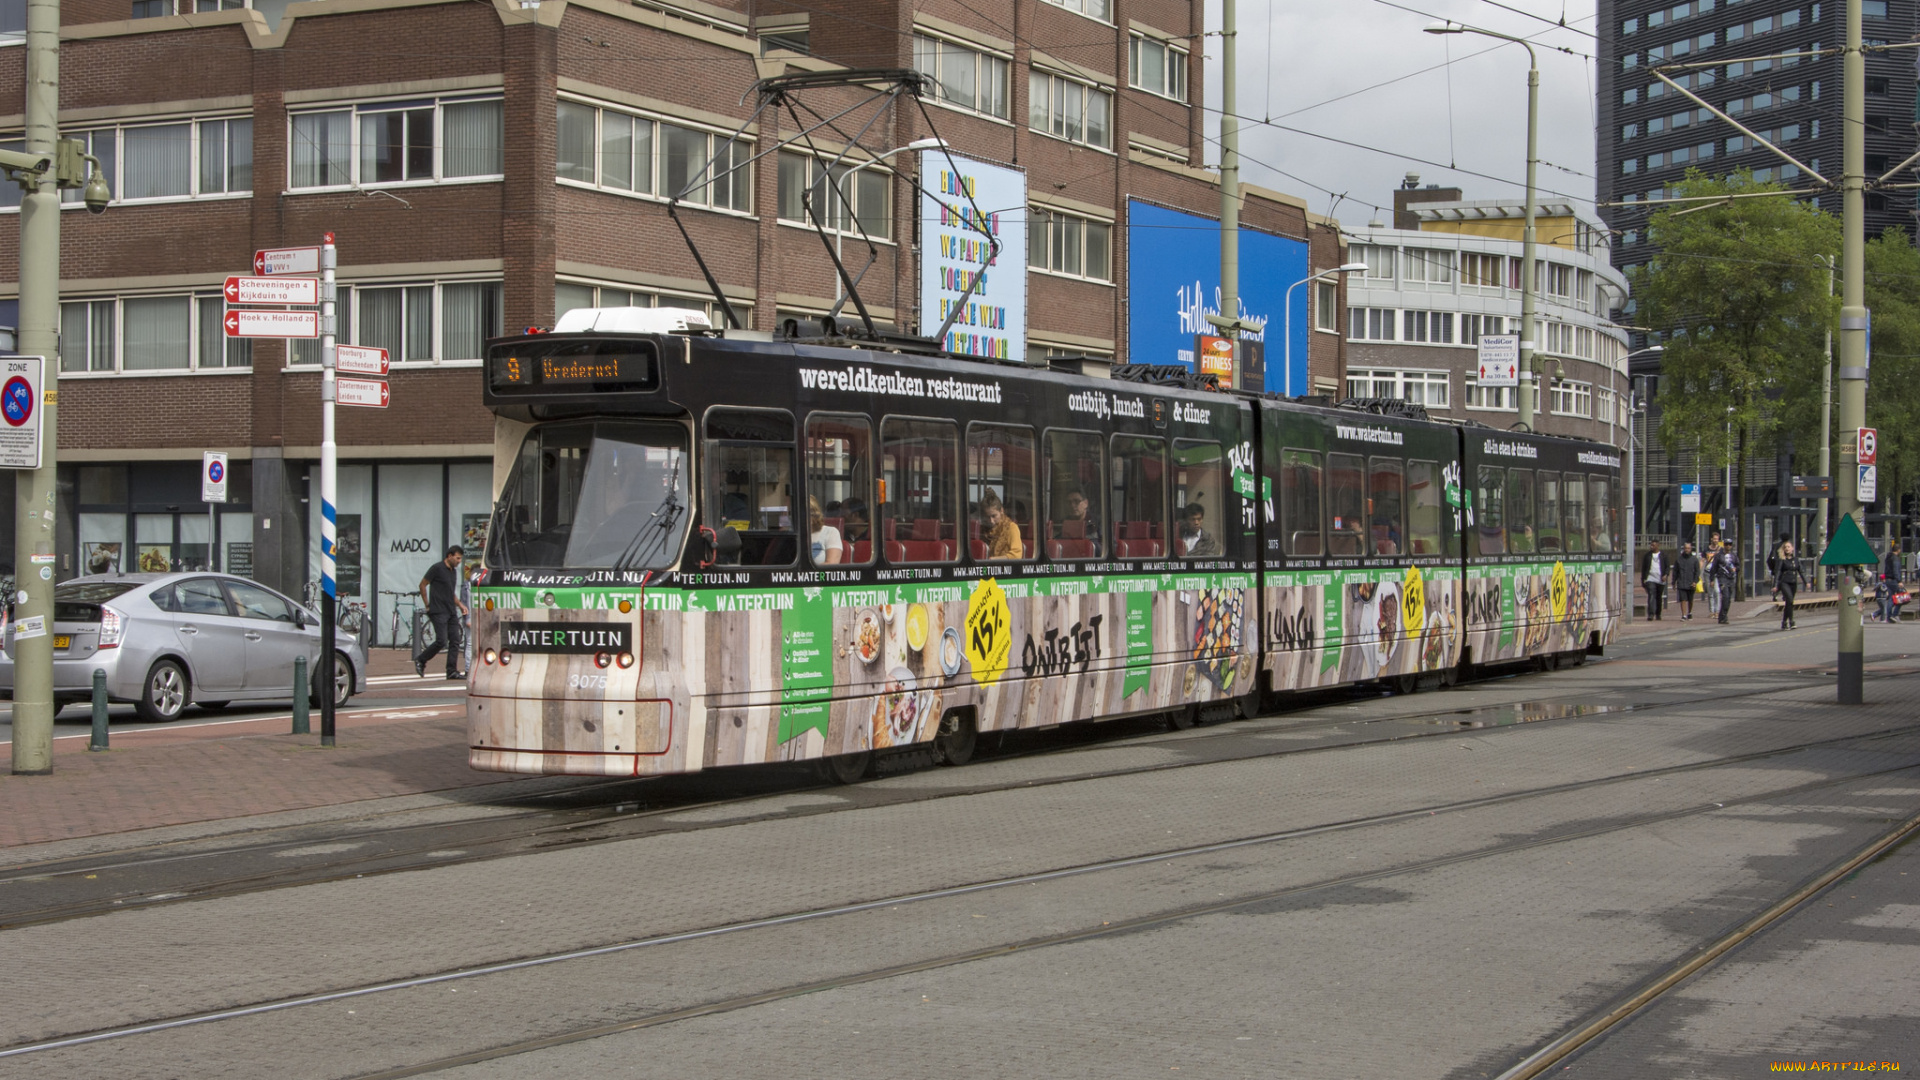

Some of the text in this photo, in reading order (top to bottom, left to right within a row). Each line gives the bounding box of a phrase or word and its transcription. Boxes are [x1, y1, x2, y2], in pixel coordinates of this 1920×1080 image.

[941, 170, 975, 199] BROOD
[941, 202, 999, 236] BIO EIEREN
[265, 253, 291, 261] Centrum
[941, 234, 997, 266] WC PAPIER
[273, 263, 286, 271] VVV
[240, 280, 300, 290] Scheveningen
[940, 266, 988, 295] YOGHURT
[240, 291, 276, 300] Kijkduin
[272, 314, 303, 322] Holland
[980, 304, 1005, 330] WIJN
[982, 335, 1009, 360] VOOR
[7, 362, 28, 372] ZONE
[507, 357, 619, 382] 9 Vrederust
[1202, 355, 1232, 371] FITNESS
[799, 366, 1002, 404] wereldkeuken restaurant
[1068, 391, 1111, 420] ontbijt,
[1113, 394, 1145, 418] lunch
[1173, 401, 1182, 422] &
[1184, 402, 1211, 425] diner
[1336, 425, 1404, 446] www.watertuin.nu
[390, 538, 431, 553] MADO
[877, 568, 942, 580] WWW.WATERTUIN.NU
[953, 565, 1013, 577] WWW.WATERTUIN.NU
[1022, 563, 1076, 574] WWW.WATERTUIN.NU
[1085, 562, 1134, 572] WWW.WATERTUIN.NU
[1142, 561, 1187, 571] WWW.WATERTUIN.NU
[771, 570, 861, 583] WWW.WATERTUIN.NU
[1176, 577, 1207, 590] WATERTUIN
[916, 586, 962, 604] WATERTUIN
[1050, 581, 1088, 597] WATERTUIN
[716, 593, 794, 611] WATERTUIN
[832, 590, 889, 607] WATERTUIN
[972, 600, 1003, 661] 15%
[1266, 605, 1314, 652] LUNCH
[507, 629, 622, 647] WATERTUIN
[1021, 614, 1103, 678] ONTBIJT
[569, 674, 607, 689] 3075
